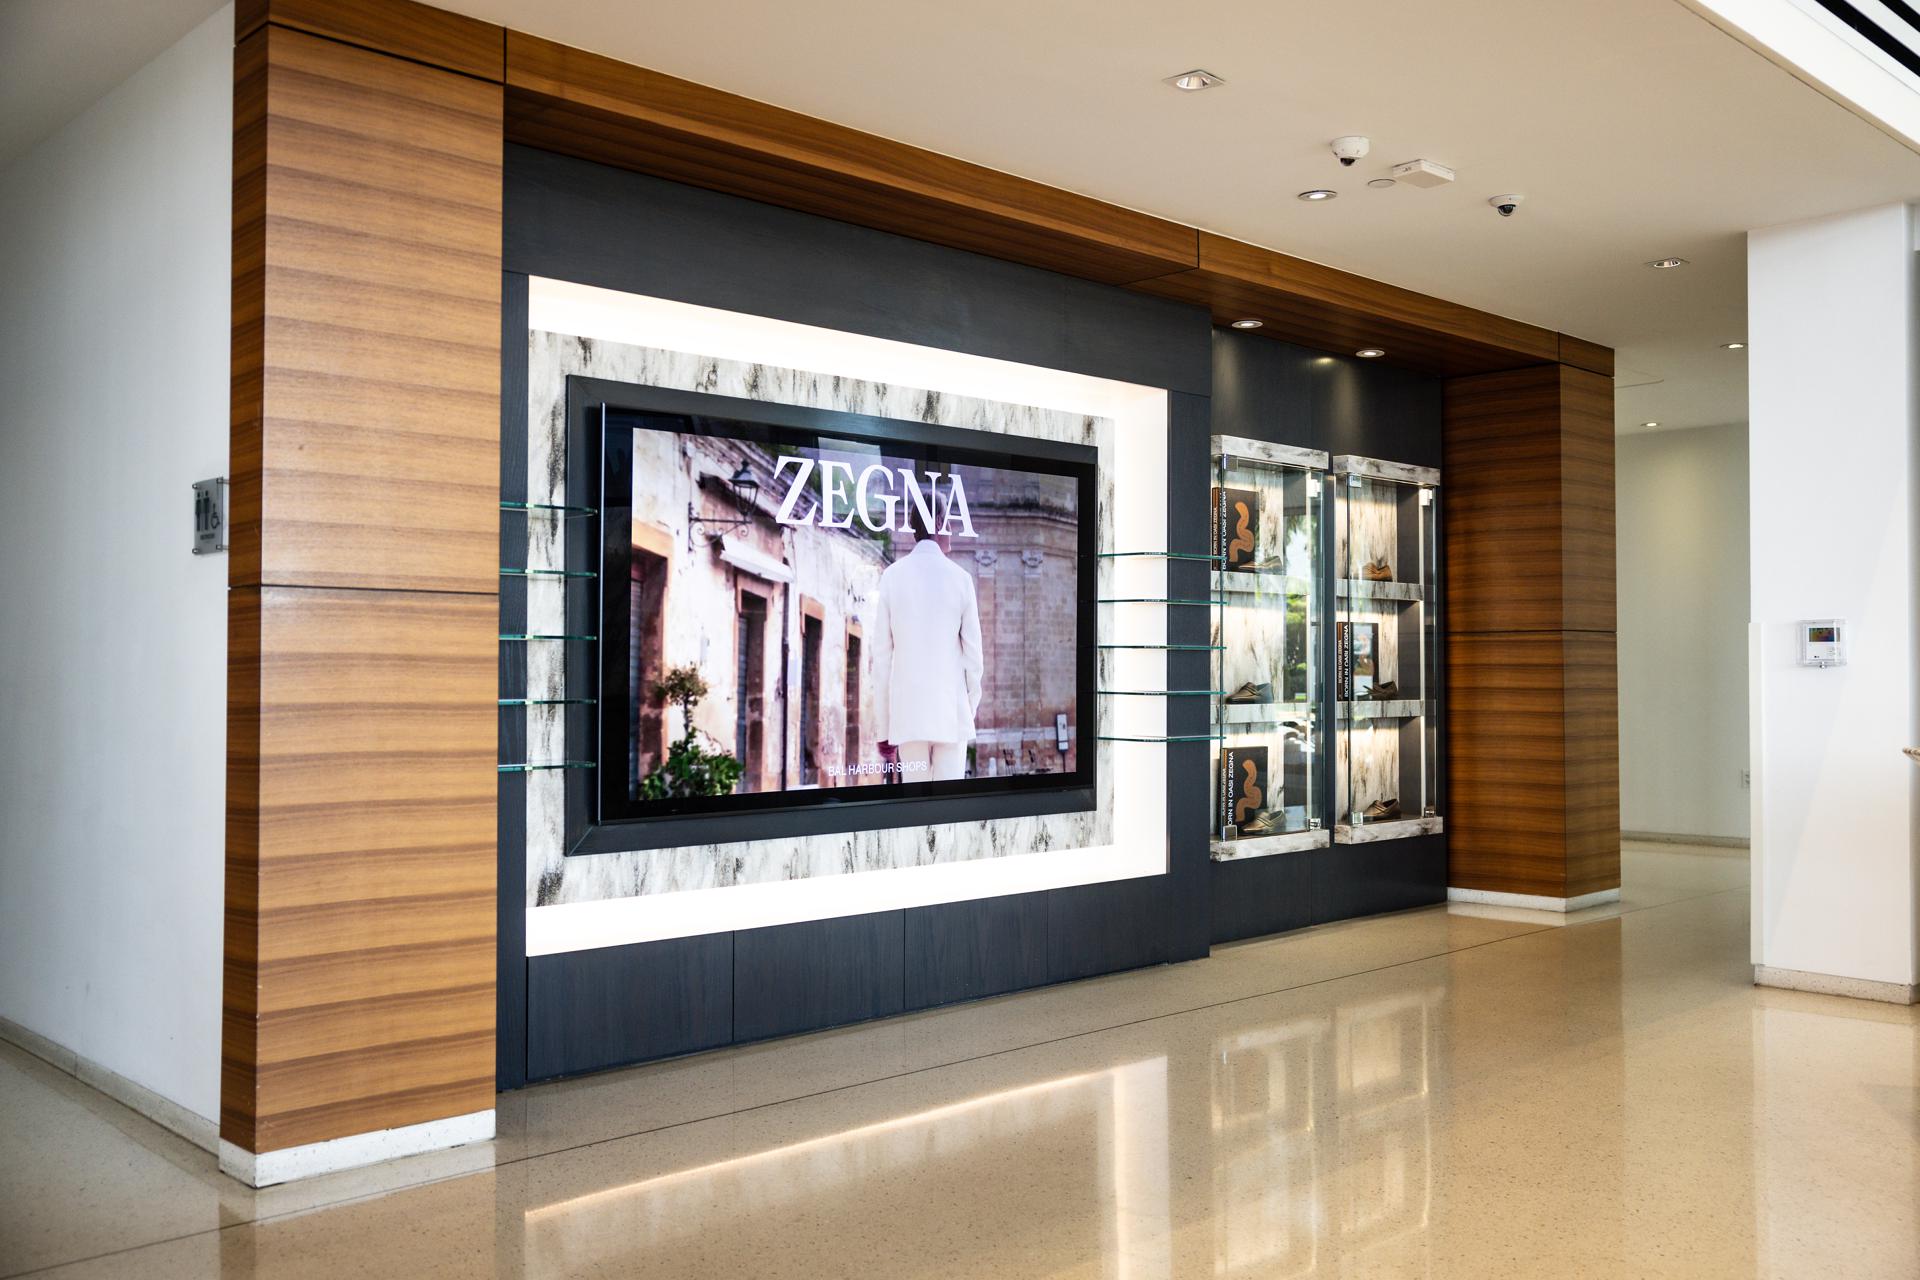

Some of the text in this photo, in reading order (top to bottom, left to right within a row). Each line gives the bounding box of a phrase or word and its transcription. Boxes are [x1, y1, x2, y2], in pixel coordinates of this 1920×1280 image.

[774, 455, 979, 538] ZEGNA
[1343, 668, 1349, 676] IN
[828, 761, 928, 777] BAL HARBOUR SHOPS
[1227, 799, 1233, 808] IN
